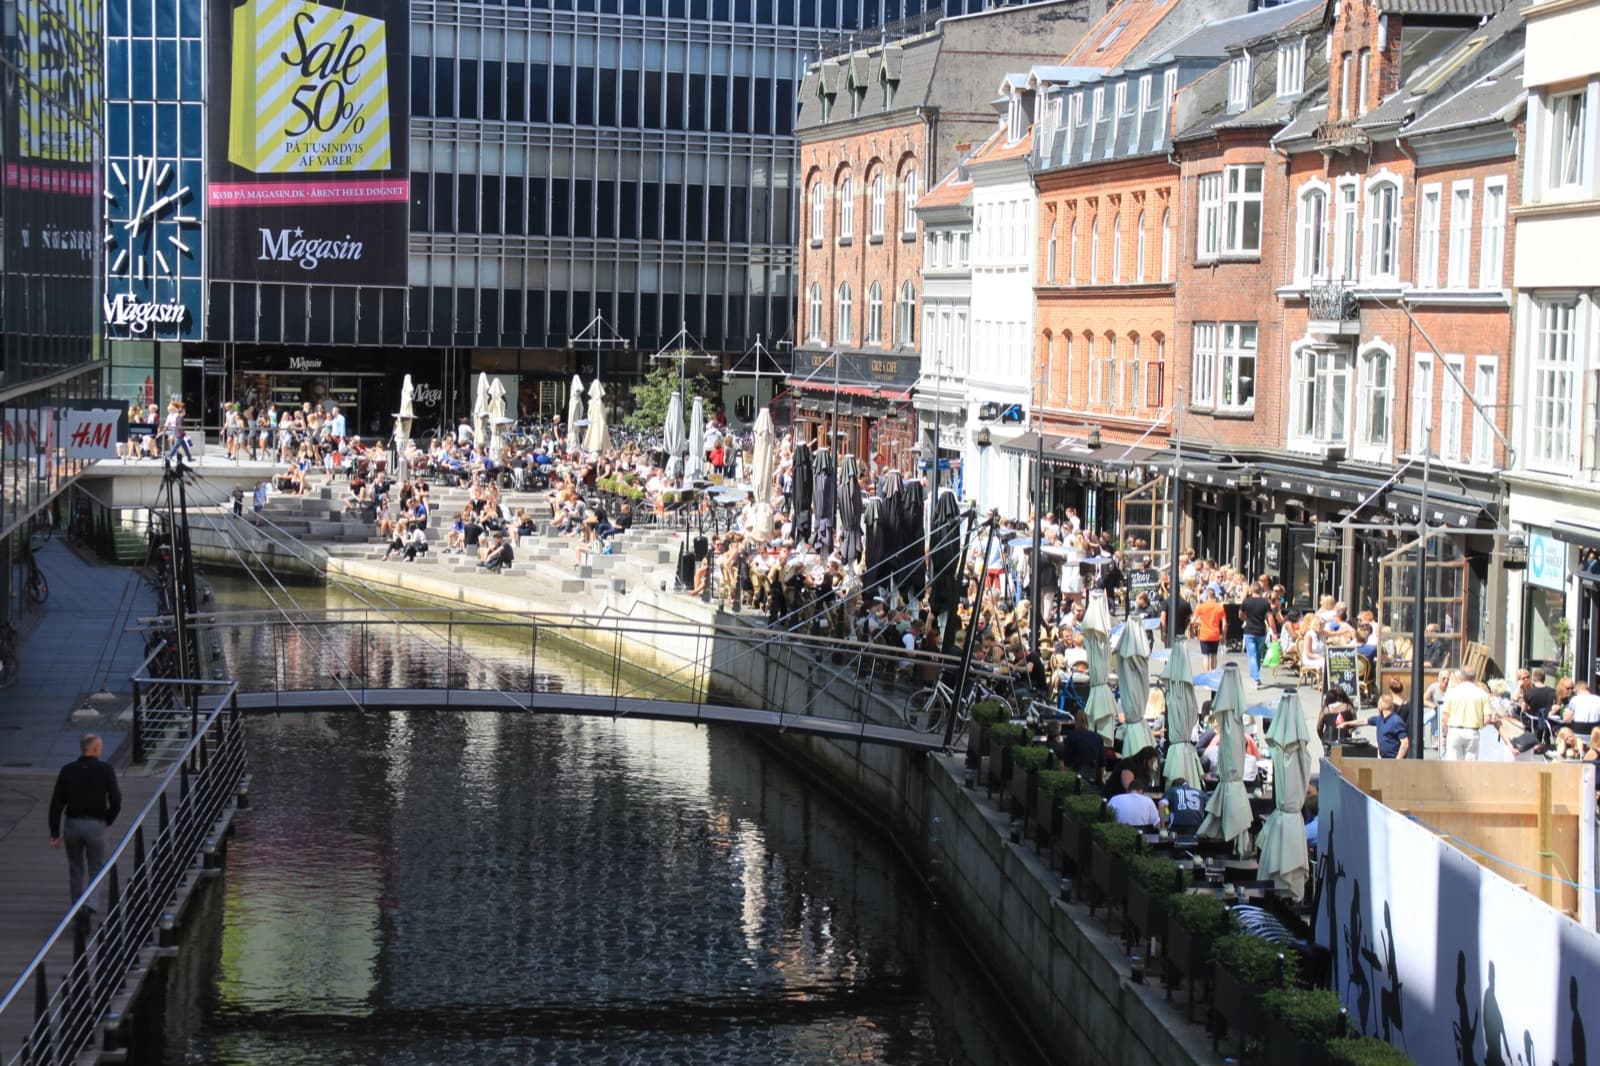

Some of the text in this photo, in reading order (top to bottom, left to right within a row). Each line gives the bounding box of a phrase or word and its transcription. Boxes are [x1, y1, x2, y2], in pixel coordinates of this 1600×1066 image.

[281, 12, 366, 85] Sale
[284, 80, 365, 137] 50%
[285, 140, 364, 153] PÅ TUSINDVIS
[299, 155, 353, 166] AF VARER
[342, 187, 366, 197] HELE
[257, 226, 363, 270] Magasin
[104, 292, 185, 333] Magasin
[71, 422, 113, 449] H&M
[1176, 789, 1201, 811] 15
